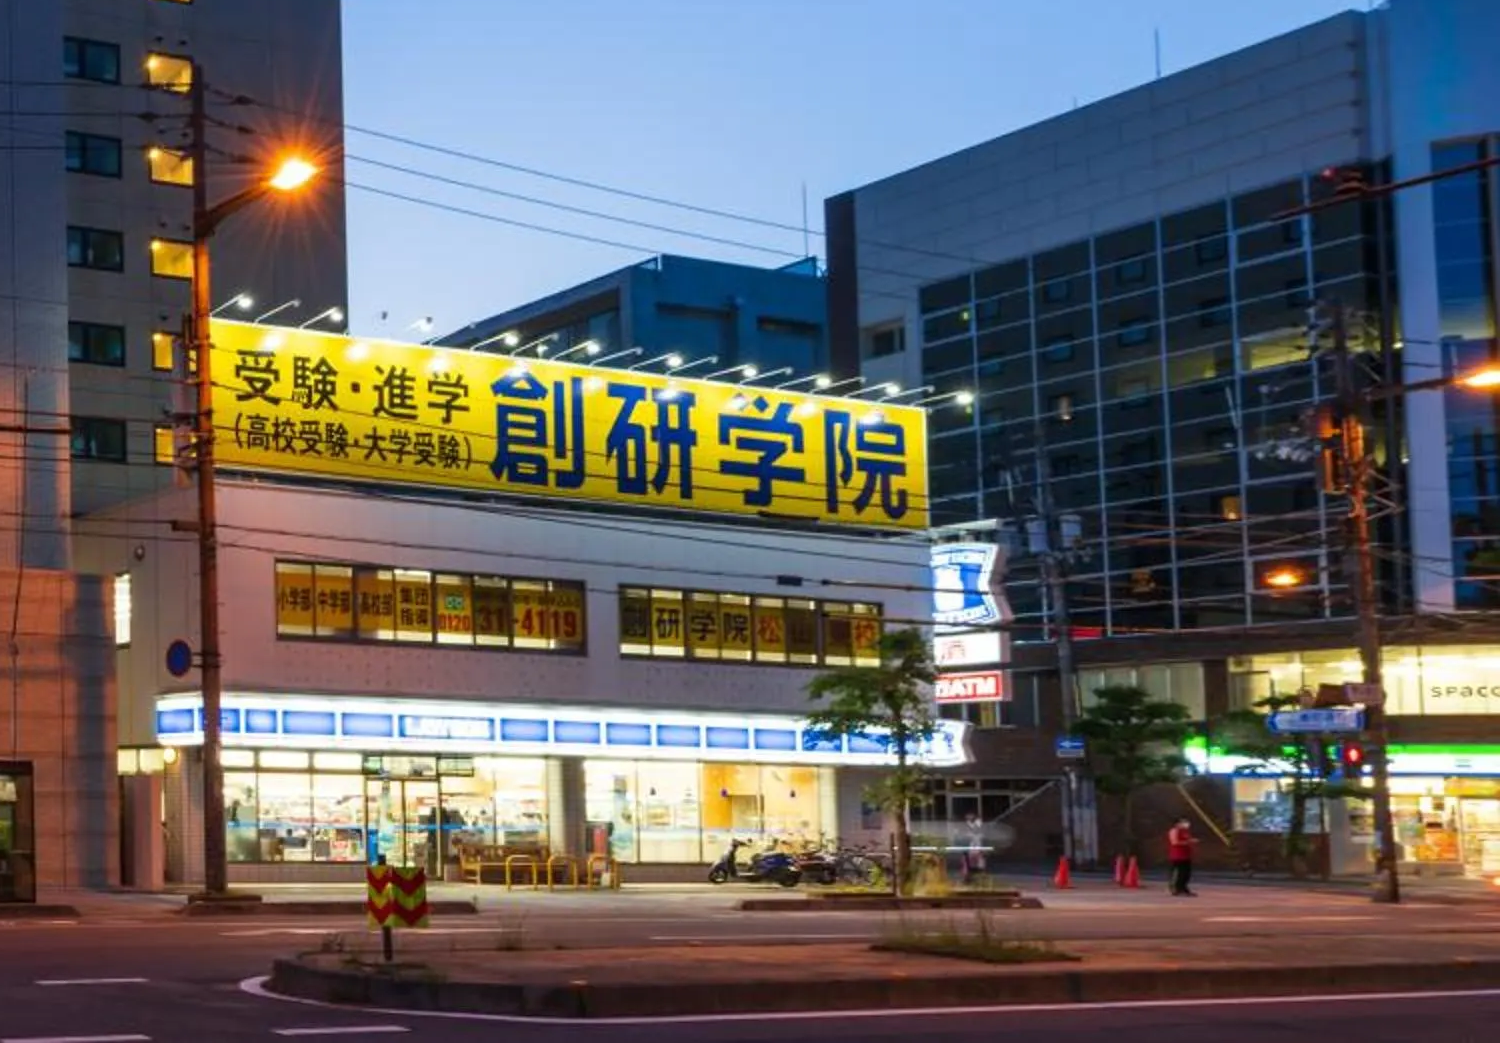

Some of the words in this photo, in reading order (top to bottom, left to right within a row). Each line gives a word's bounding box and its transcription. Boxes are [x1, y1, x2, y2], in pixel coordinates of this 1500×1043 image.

[235, 349, 470, 424] 受験・進学
[489, 369, 908, 519] 創研学院
